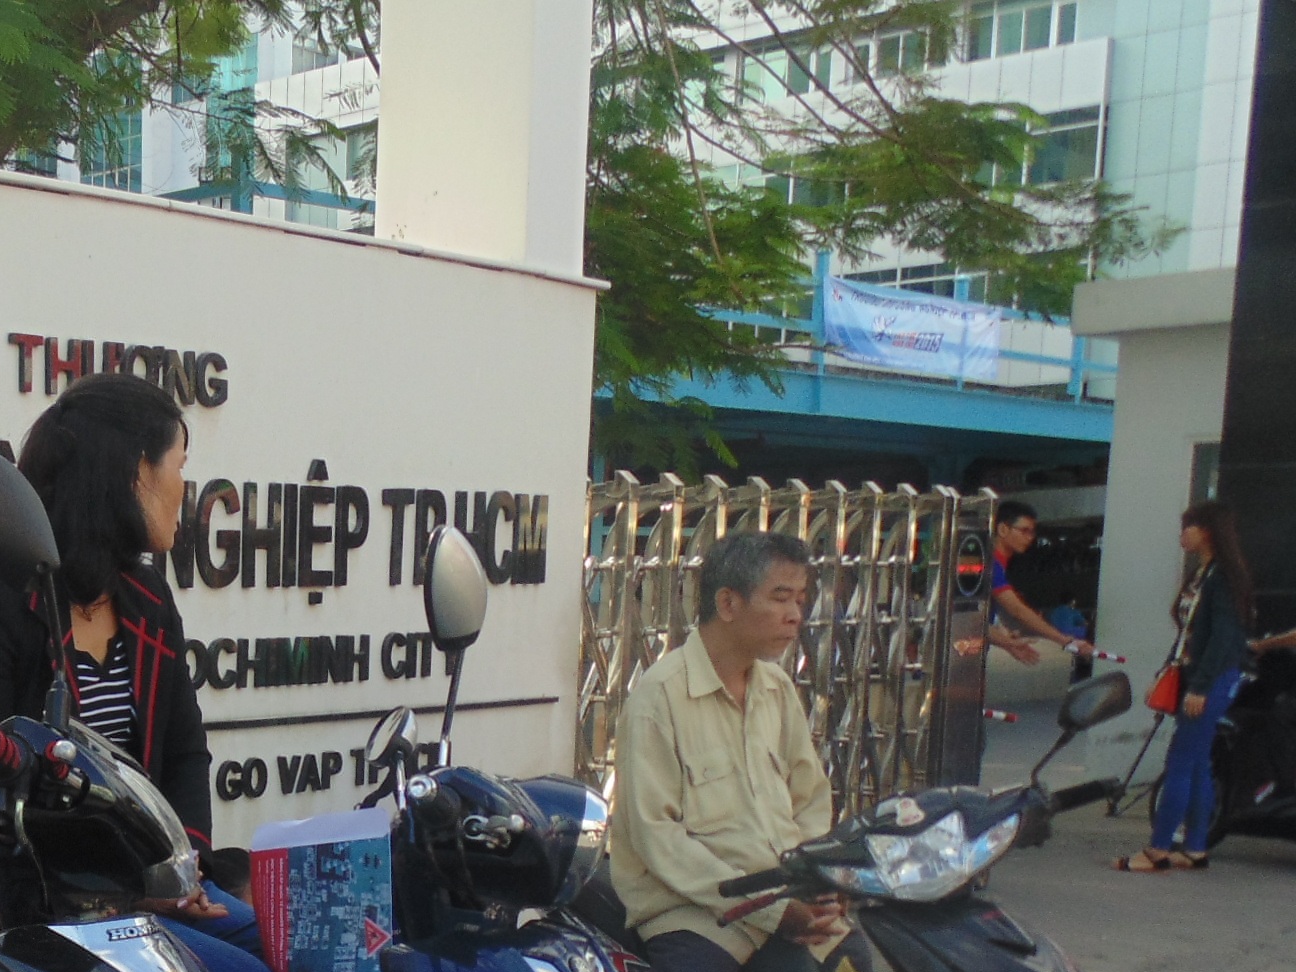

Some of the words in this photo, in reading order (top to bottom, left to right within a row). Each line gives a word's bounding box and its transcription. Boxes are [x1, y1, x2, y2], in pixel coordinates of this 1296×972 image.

[915, 334, 942, 351] 2015
[184, 635, 370, 691] OCHIMINH
[216, 758, 268, 801] GO
[276, 751, 343, 795] VAP
